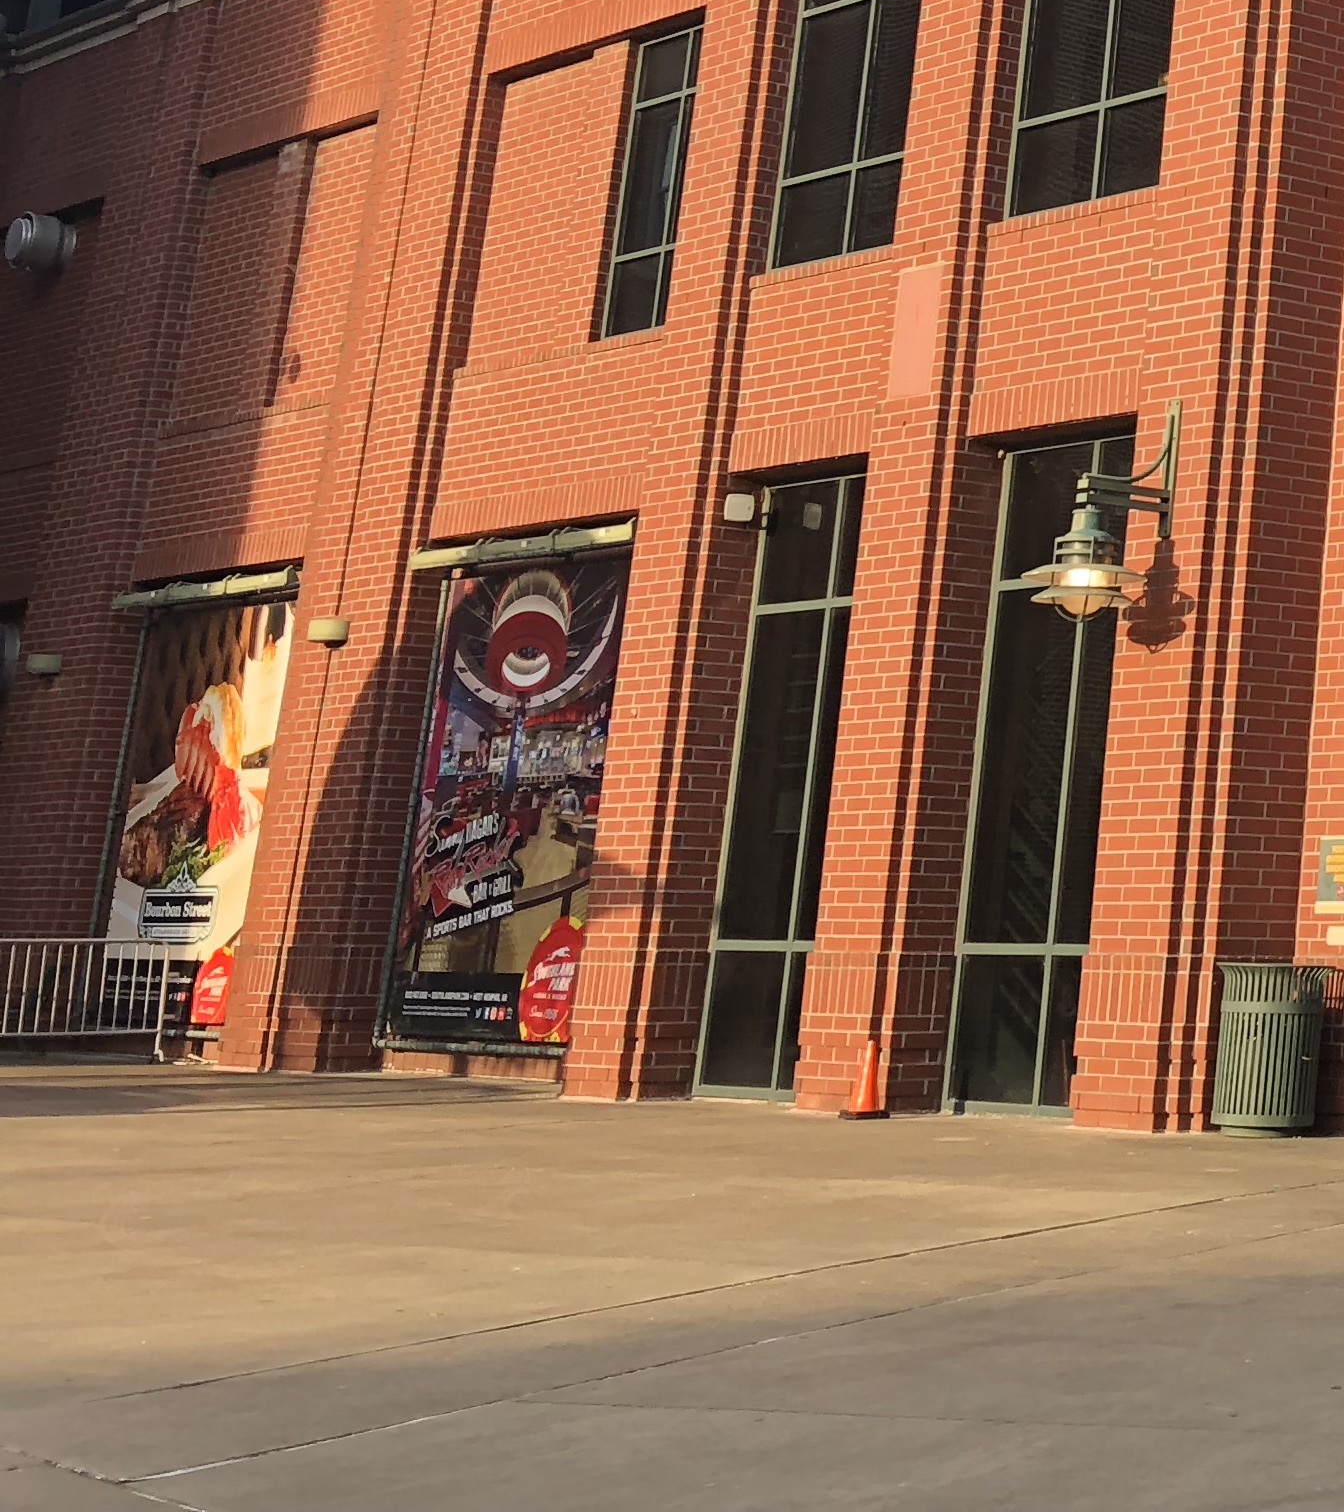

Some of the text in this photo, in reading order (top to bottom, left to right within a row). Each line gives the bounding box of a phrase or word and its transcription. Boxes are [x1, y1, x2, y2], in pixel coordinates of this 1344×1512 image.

[144, 901, 212, 918] Bourbon Street
[433, 918, 458, 937] SPORTS
[458, 913, 473, 929] BAR
[473, 906, 490, 924] THAT
